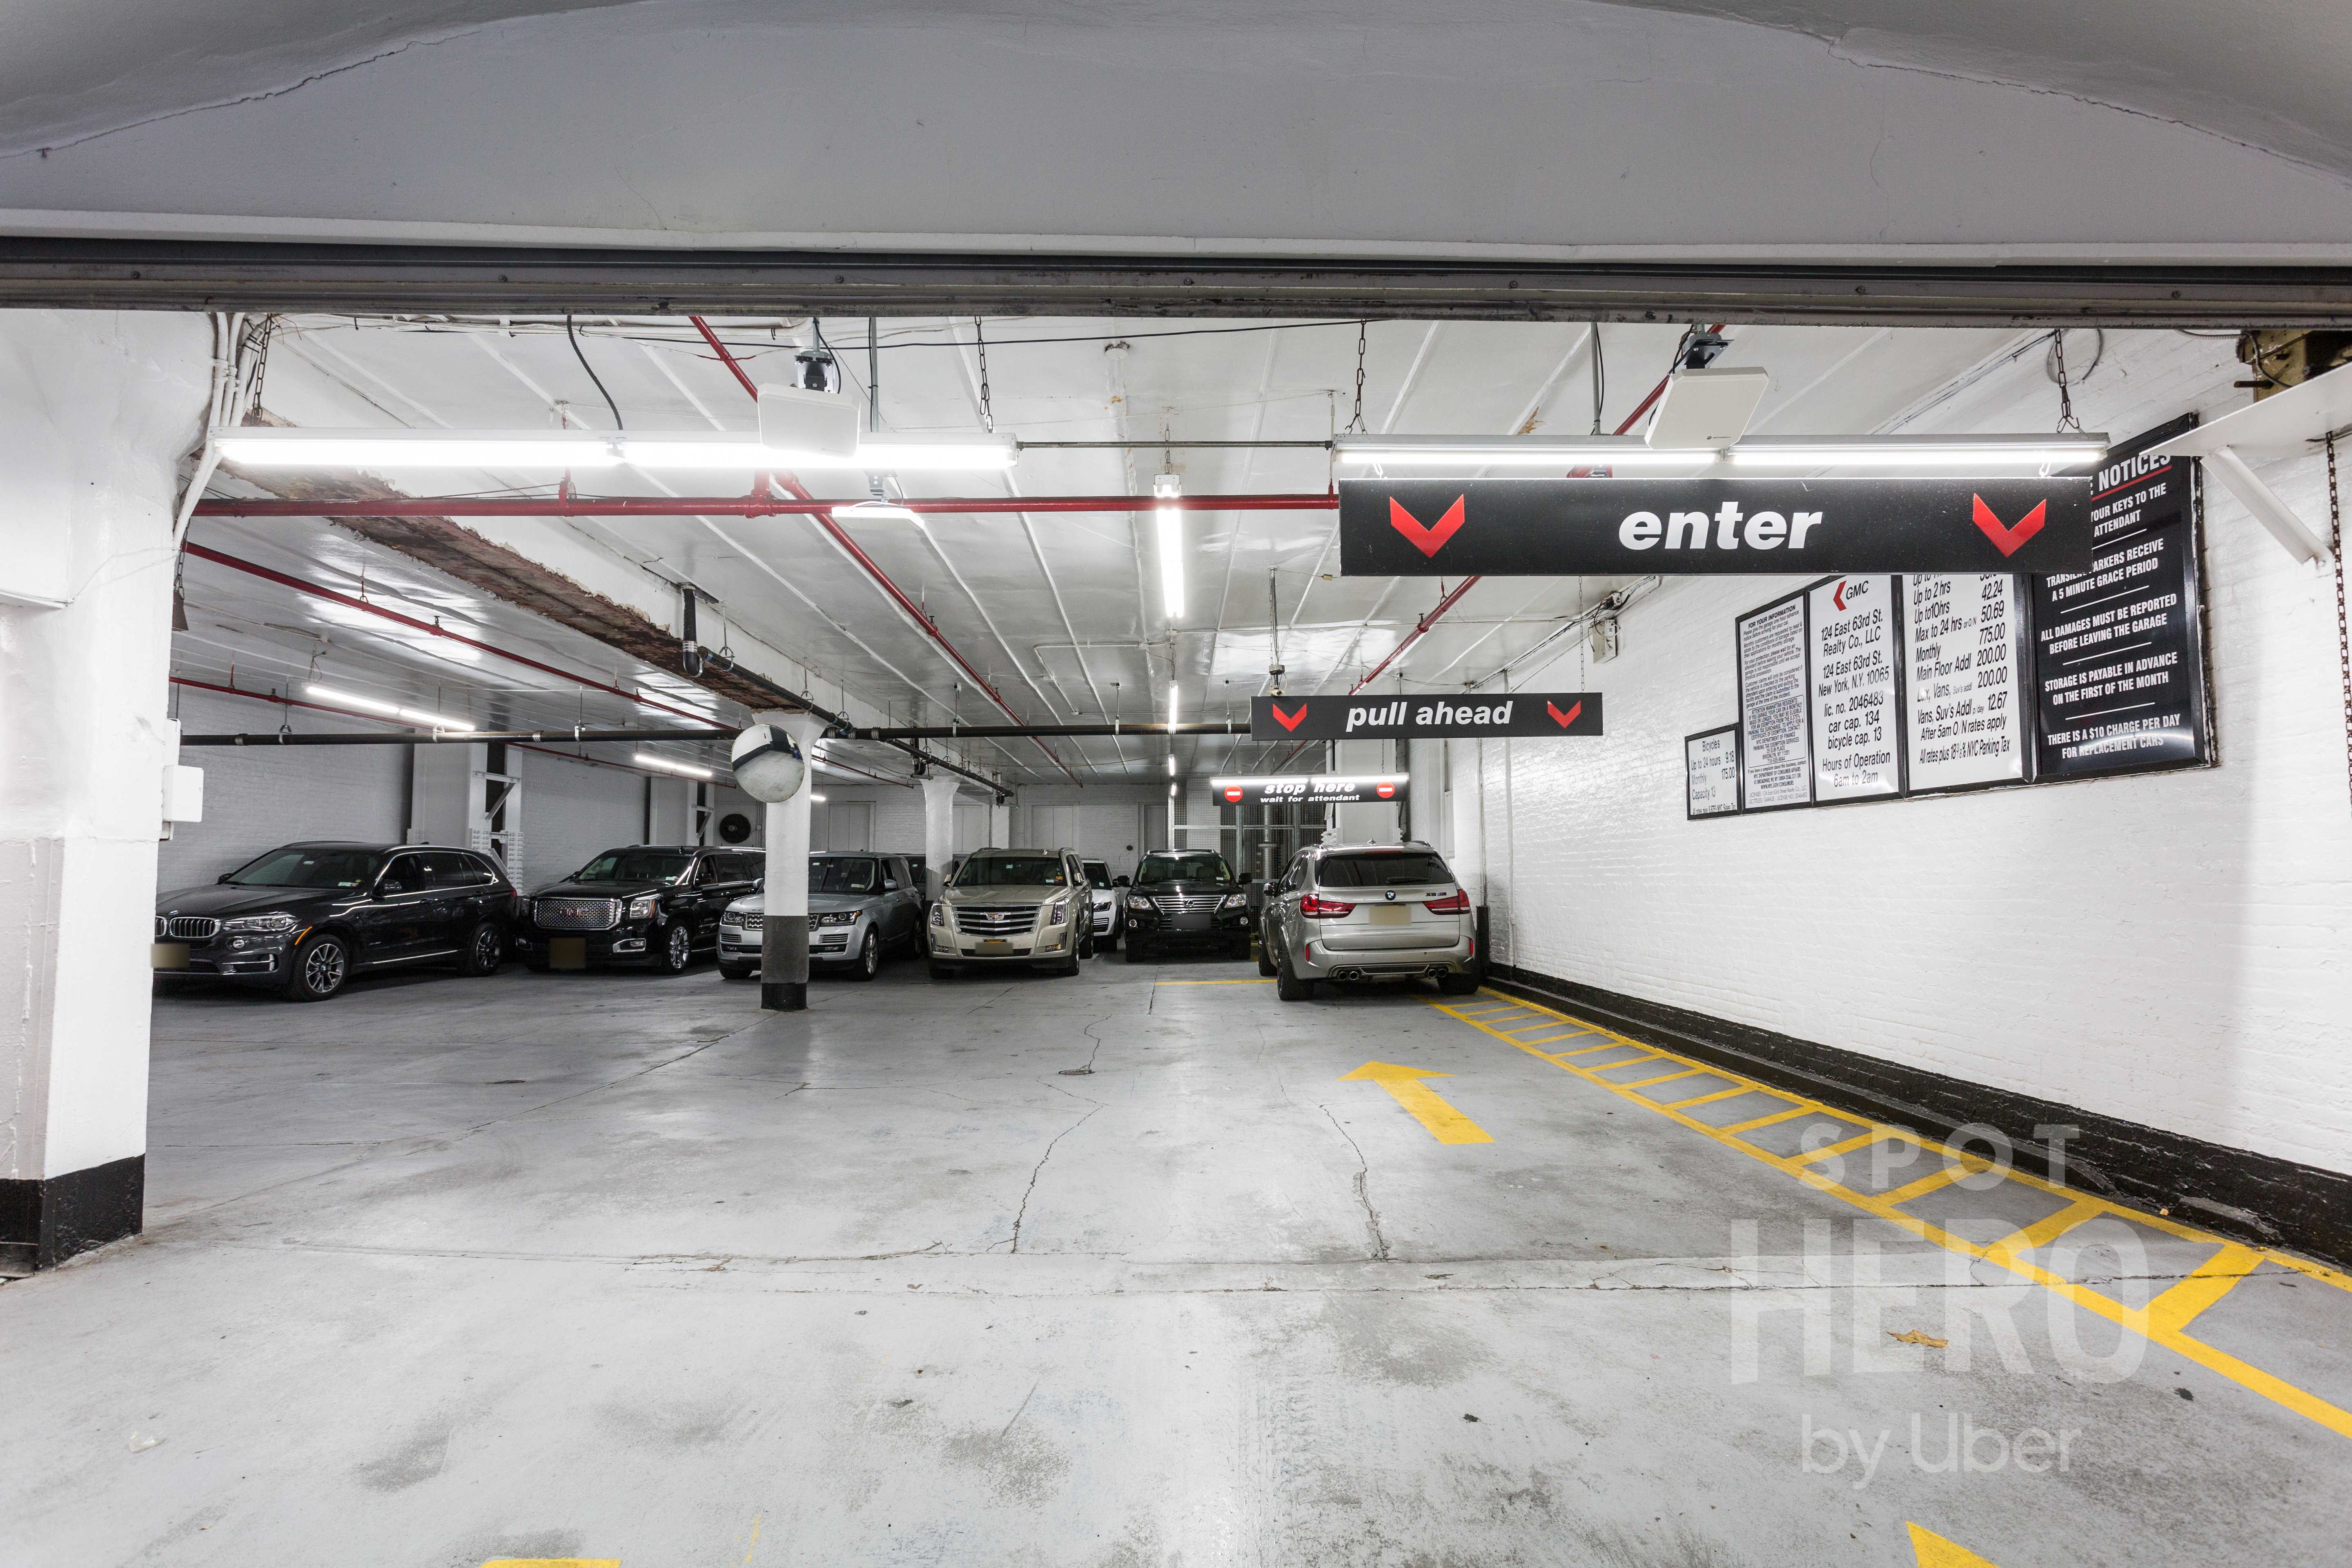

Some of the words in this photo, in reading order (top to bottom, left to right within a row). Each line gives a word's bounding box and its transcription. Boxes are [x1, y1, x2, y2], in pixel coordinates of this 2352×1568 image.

[2098, 454, 2171, 492] NOTICES
[2113, 496, 2133, 514] KEYS
[2135, 491, 2146, 504] TO
[2149, 483, 2166, 499] THE
[1619, 501, 1823, 550] enter
[2094, 510, 2141, 537] ATTENDANT
[2046, 572, 2087, 588] TRANSI
[2091, 552, 2124, 573] ARKERS
[2127, 538, 2164, 561] RECEIVE
[1846, 581, 1869, 600] GMC
[1982, 579, 2003, 601] 42.24
[2052, 590, 2058, 601] A
[2059, 588, 2064, 599] 5
[2066, 577, 2095, 597] MINUTE
[2097, 569, 2124, 587] GRACE
[2126, 557, 2158, 578] PERIOD
[1914, 589, 1922, 607] Up
[1925, 587, 1931, 601] to
[1933, 582, 1938, 598] 2
[1940, 580, 1951, 596] hrs
[1757, 617, 1767, 625] YOUR
[1768, 605, 1795, 621] INFORMATION
[1915, 608, 1923, 626] Up
[1981, 600, 2004, 622] 50.69
[2041, 629, 2054, 641] ALL
[2055, 618, 2091, 638] DAMAGES
[2092, 611, 2115, 627] MUST
[2117, 607, 2128, 620] BE
[2130, 593, 2177, 617] REPORTED
[1822, 625, 1832, 641] 124
[1834, 620, 1850, 637] East
[1853, 612, 1870, 631] 63rd
[1873, 609, 1883, 624] St.
[1915, 627, 1929, 643] Max
[1931, 624, 1938, 637] to
[1940, 618, 1949, 635] 24
[1951, 617, 1962, 632] hrs
[1980, 622, 2005, 645] 775.00
[2050, 637, 2078, 654] BEFORE
[2080, 628, 2112, 647] LEAVING
[2114, 623, 2130, 637] THE
[2132, 613, 2167, 633] GARAGE
[1824, 639, 1846, 657] Realty
[1849, 635, 1862, 649] Co.,
[1865, 626, 1881, 644] LLC
[1916, 642, 1941, 663] Monthly
[1823, 664, 1833, 679] 124
[1836, 659, 1851, 675] East
[1853, 653, 1870, 670] 63rd
[1873, 650, 1882, 665] St.
[1917, 665, 1932, 682] Main
[1934, 661, 1953, 677] Floor
[1954, 653, 1971, 673] Addl
[1977, 644, 2006, 666] 200.00
[2045, 675, 2078, 692] STORAGE
[2079, 673, 2087, 684] IS
[2089, 664, 2123, 682] PAYABLE
[2125, 662, 2134, 674] IN
[2136, 652, 2178, 672] ADVANCE
[1819, 684, 1832, 697] New
[1834, 677, 1849, 693] York,
[1852, 673, 1864, 688] N.Y.
[1867, 666, 1889, 685] 10065
[1934, 683, 1951, 698] Vans,
[1978, 666, 2007, 688] 200.00
[2053, 693, 2063, 705] ON
[2065, 690, 2079, 703] THE
[2081, 685, 2103, 699] FIRST
[2105, 682, 2116, 694] OF
[2118, 678, 2134, 693] THE
[2136, 671, 2169, 688] MONTH
[1346, 702, 1407, 732] pull
[1415, 701, 1513, 725] ahead
[1824, 703, 1833, 717] lic.
[1836, 703, 1846, 714] no.
[1849, 690, 1883, 711] 2046483
[1918, 709, 1933, 725] Vans,
[1936, 703, 1953, 721] Suv's
[1956, 698, 1972, 717] Addl
[1988, 691, 2007, 711] 12.67
[1829, 722, 1841, 733] car
[1844, 717, 1861, 731] cap.
[1865, 710, 1880, 726] 134
[1921, 728, 1936, 741] After
[1938, 724, 1951, 738] 5am
[1953, 719, 1967, 736] O/N
[1968, 719, 1984, 733] rates
[1987, 713, 2007, 732] apply
[2047, 732, 2071, 745] THERE
[2073, 731, 2080, 742] IS
[2082, 729, 2088, 740] A
[2089, 726, 2104, 739] $10
[2107, 720, 2140, 735] CHARGE
[2143, 717, 2160, 730] PER
[2163, 714, 2180, 727] DAY
[1702, 739, 1720, 752] Bicycles
[1828, 733, 1852, 751] bicycle
[1855, 733, 1870, 746] cap.
[1874, 726, 1882, 741] 13
[1926, 748, 1938, 763] rates
[1939, 746, 1949, 764] plus
[1967, 739, 1978, 757] NYC
[1980, 737, 1999, 757] Parking
[2001, 736, 2010, 752] Tax
[2062, 746, 2078, 759] FOR
[2079, 737, 2137, 756] REPLACEMENT
[2140, 735, 2164, 748] CARS
[1691, 760, 1696, 772] Up
[1698, 761, 1702, 769] to
[1704, 757, 1708, 768] 24
[1710, 755, 1721, 766] hours
[1726, 751, 1734, 763] 9.18
[1823, 758, 1842, 772] Hours
[1844, 755, 1851, 768] of
[1854, 750, 1890, 770] Operation
[1265, 784, 1306, 795] stop
[1314, 781, 1355, 793] here
[1692, 773, 1707, 785] Monthly
[1722, 766, 1735, 780] 175.00
[1834, 773, 1849, 787] 6am
[1852, 772, 1859, 785] to
[1862, 770, 1878, 784] 2am
[1692, 788, 1710, 802] Capacity
[1711, 786, 1715, 797] 13
